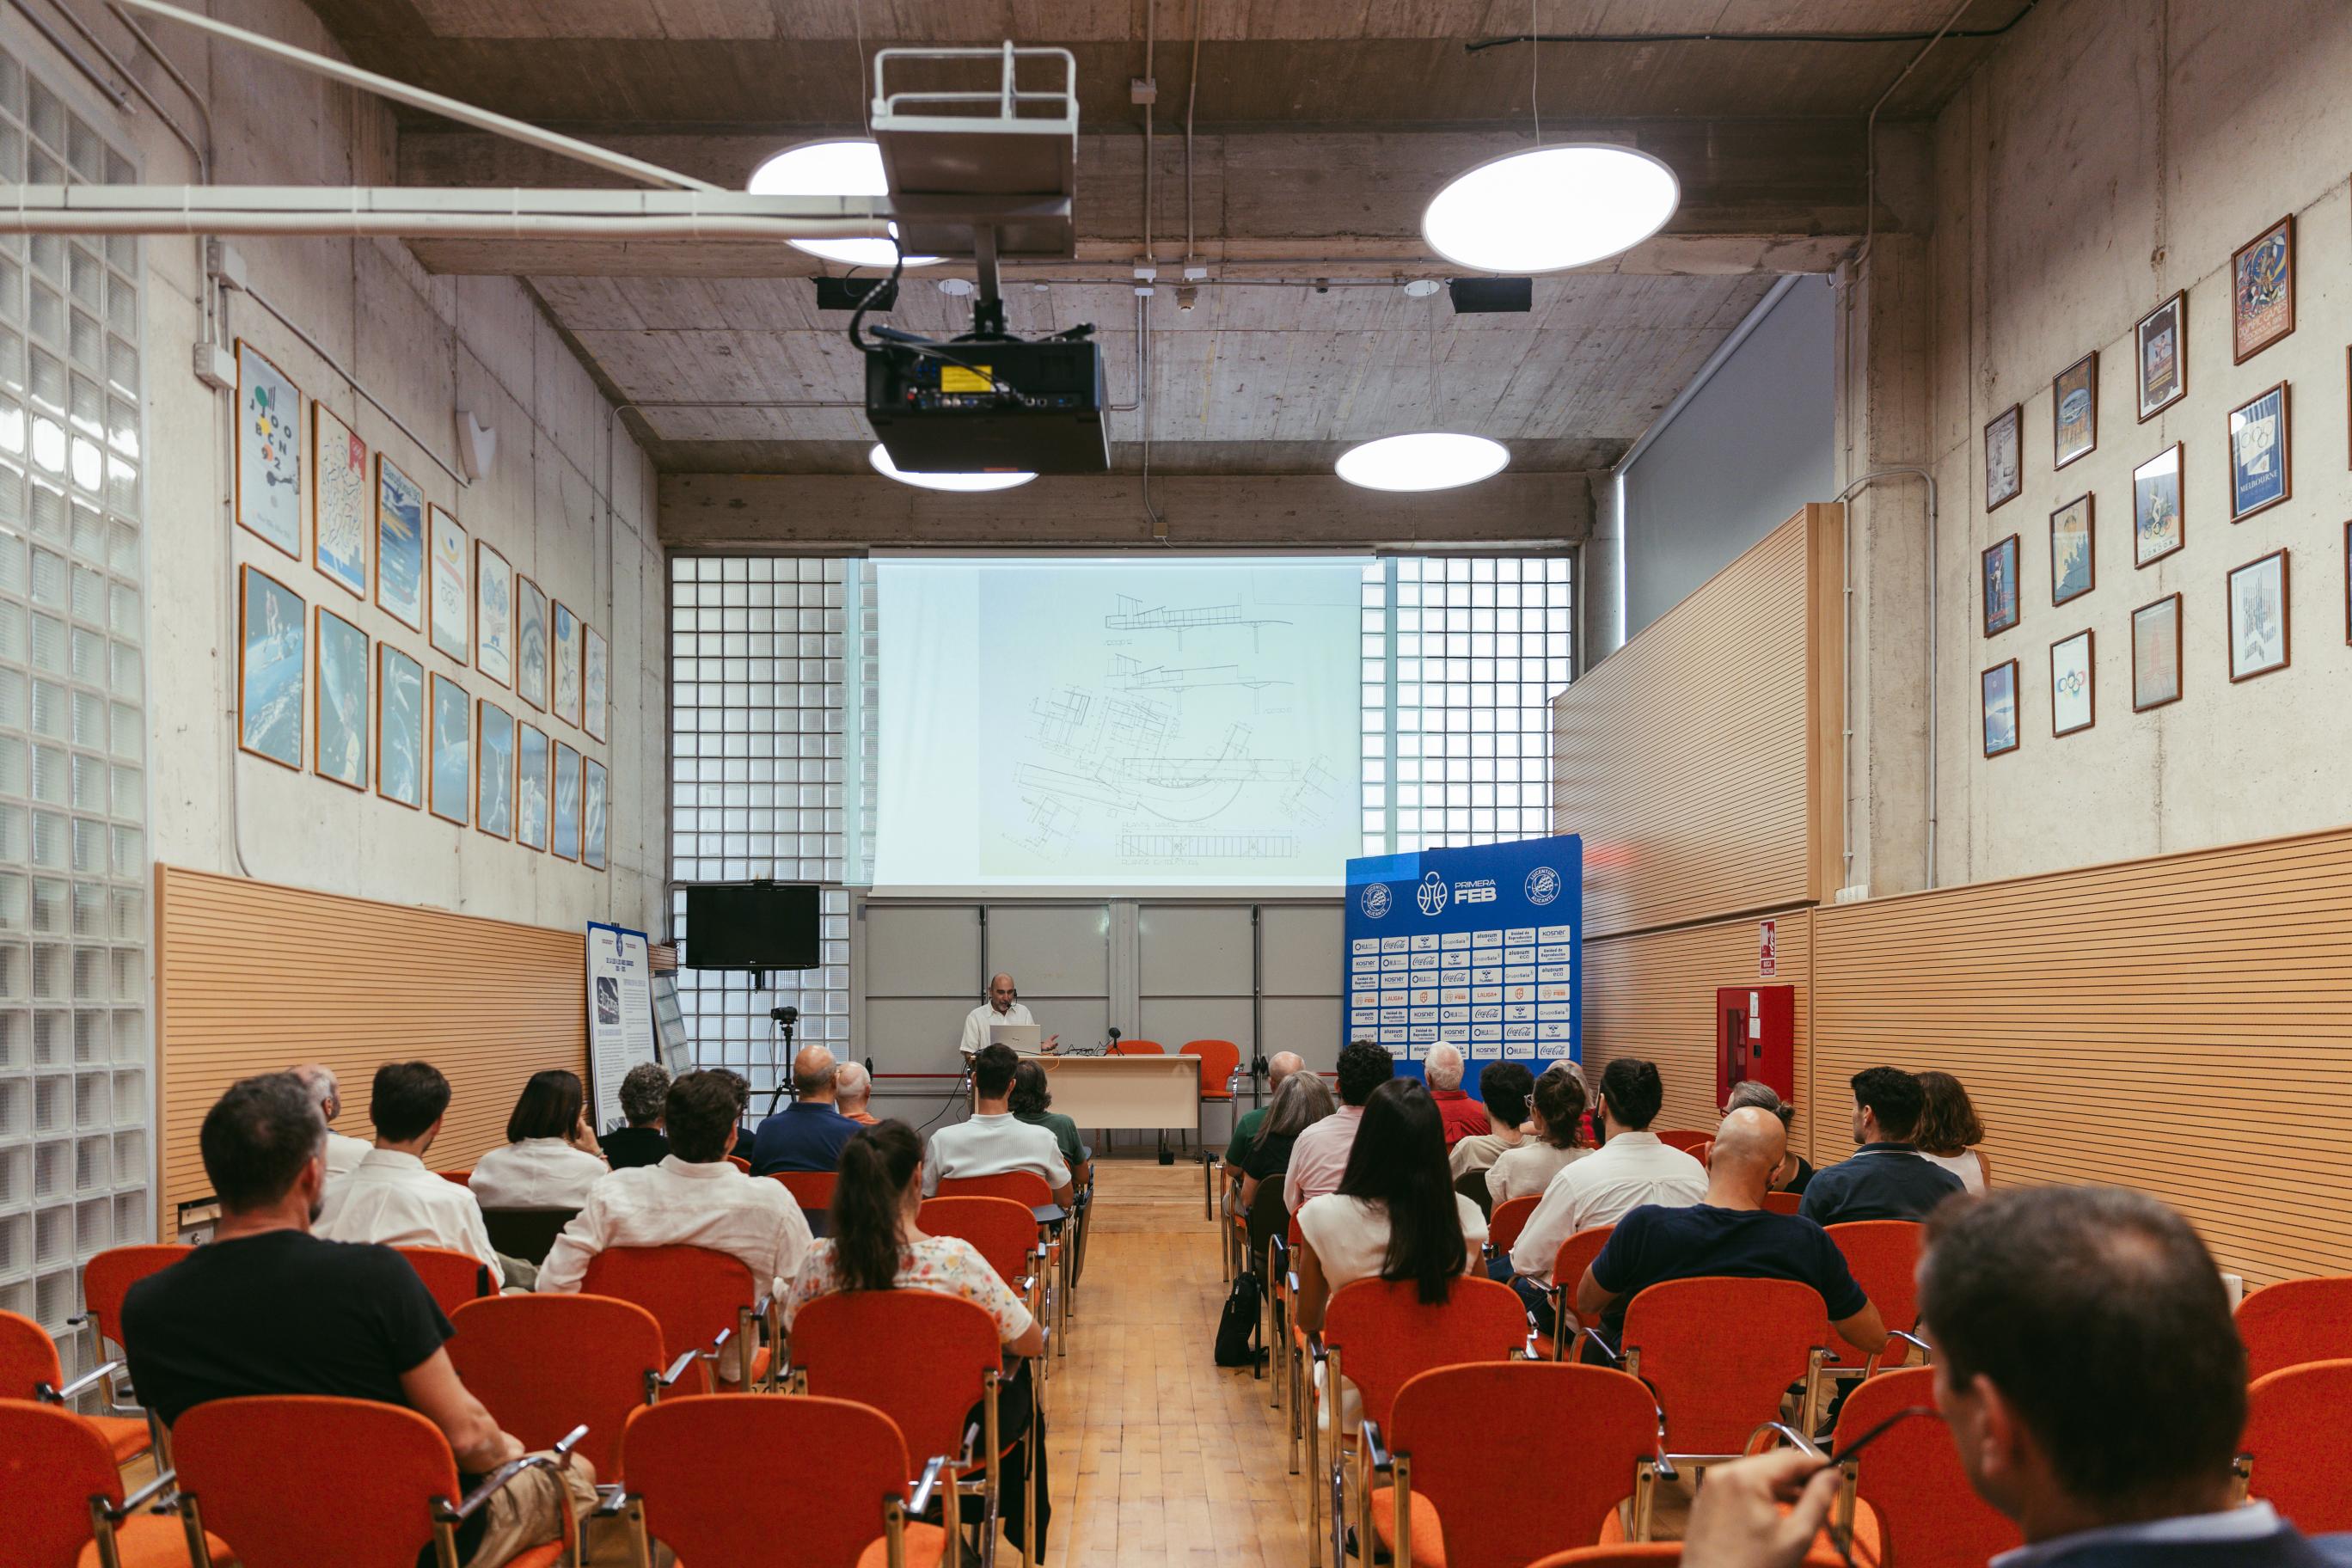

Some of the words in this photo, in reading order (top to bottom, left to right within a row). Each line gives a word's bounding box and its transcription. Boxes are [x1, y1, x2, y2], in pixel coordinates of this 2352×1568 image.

[2240, 469, 2278, 493] MELBOURNE
[1529, 868, 1556, 880] LUCENTUM
[1365, 884, 1388, 896] LUCENTUM
[1455, 879, 1497, 890] PRIMERA
[1455, 887, 1498, 904] FEB
[1530, 894, 1554, 903] ALICANTE
